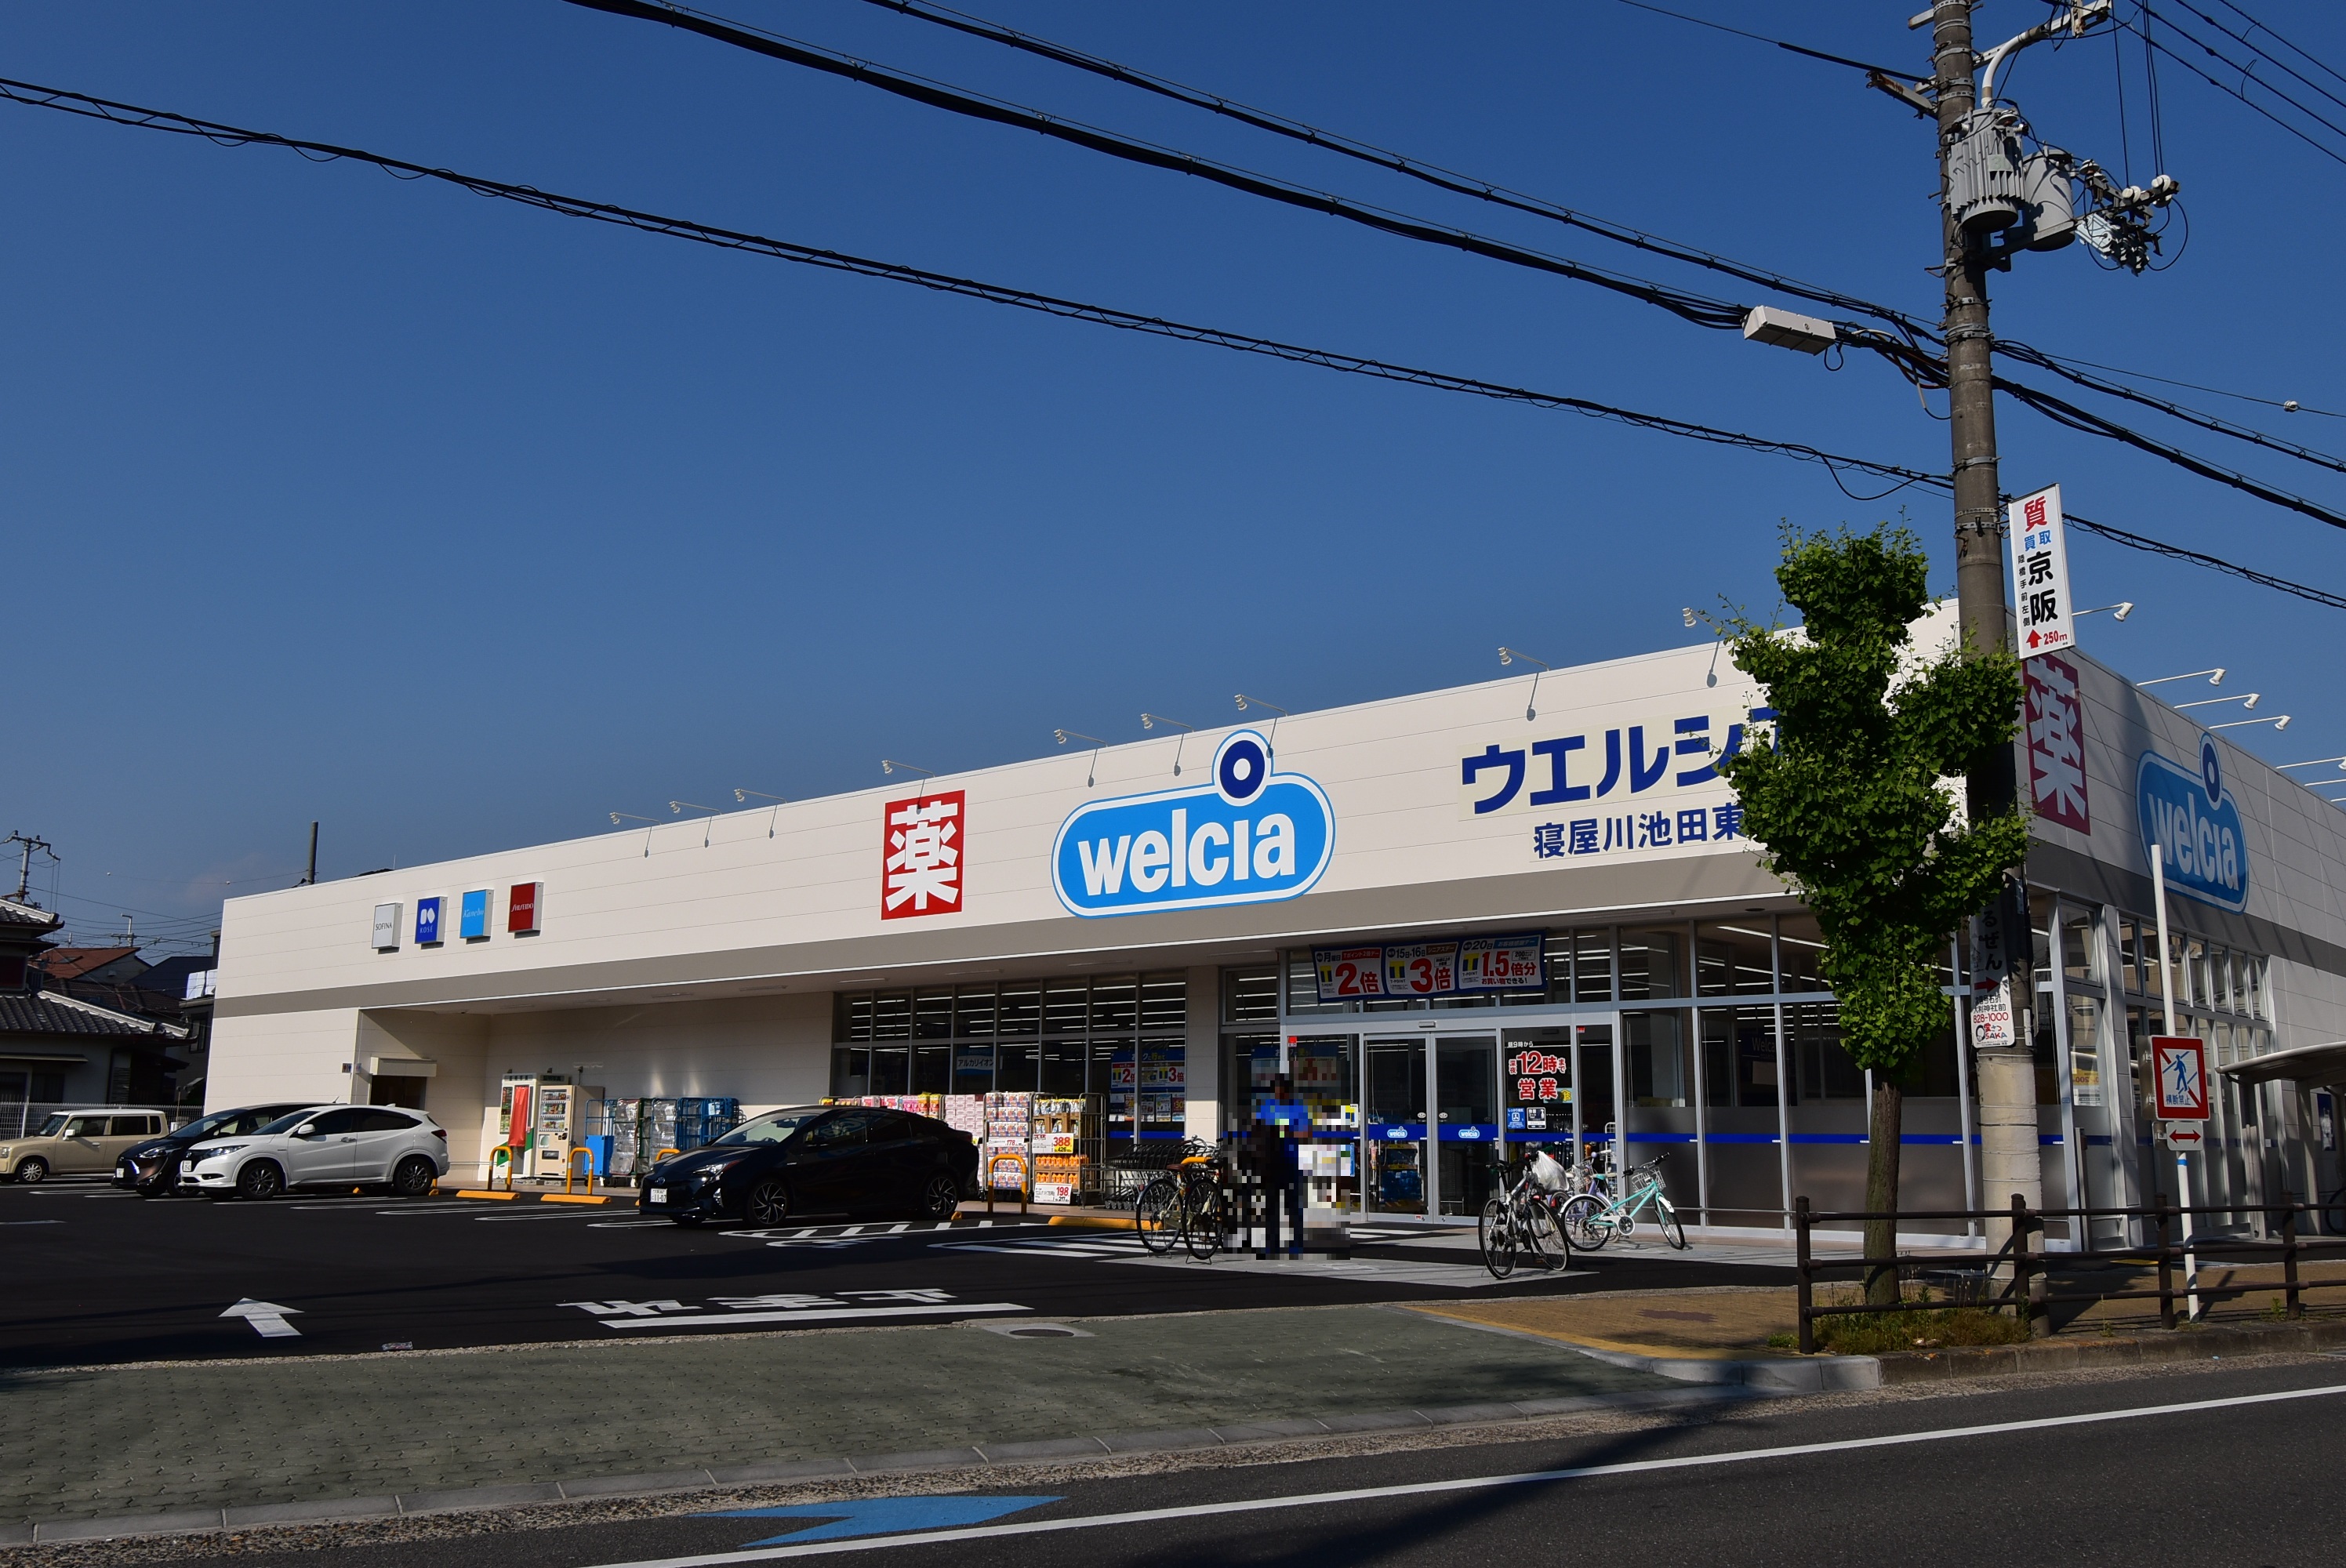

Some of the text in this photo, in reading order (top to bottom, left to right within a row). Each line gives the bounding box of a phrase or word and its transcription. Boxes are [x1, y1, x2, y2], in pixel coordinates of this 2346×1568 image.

[2023, 495, 2048, 532] 質
[2024, 530, 2052, 552] 買取
[2017, 554, 2030, 627] 陸橋手前左側
[2026, 550, 2058, 626] 京阪
[2043, 630, 2068, 645] 250m
[2026, 655, 2086, 819] 薬
[1077, 806, 1297, 898] welcia
[2147, 790, 2239, 891] welcia
[885, 801, 959, 911] 薬
[463, 908, 484, 918] Kanebo
[510, 902, 534, 912] SHISEIDO
[375, 922, 392, 931] SOFINA
[419, 924, 433, 933] KOSÉ
[1978, 900, 2003, 971] るぜん
[1335, 962, 1379, 995] 2倍
[1410, 958, 1451, 993] 3倍
[1973, 1012, 2009, 1023] 828-1000
[1516, 1051, 1557, 1074] 12時
[1557, 1058, 1567, 1074] まで
[1518, 1077, 1558, 1101] 営業
[2166, 1094, 2192, 1105] 横断禁止
[1053, 1137, 1070, 1146] 388
[1056, 1186, 1070, 1196] 198
